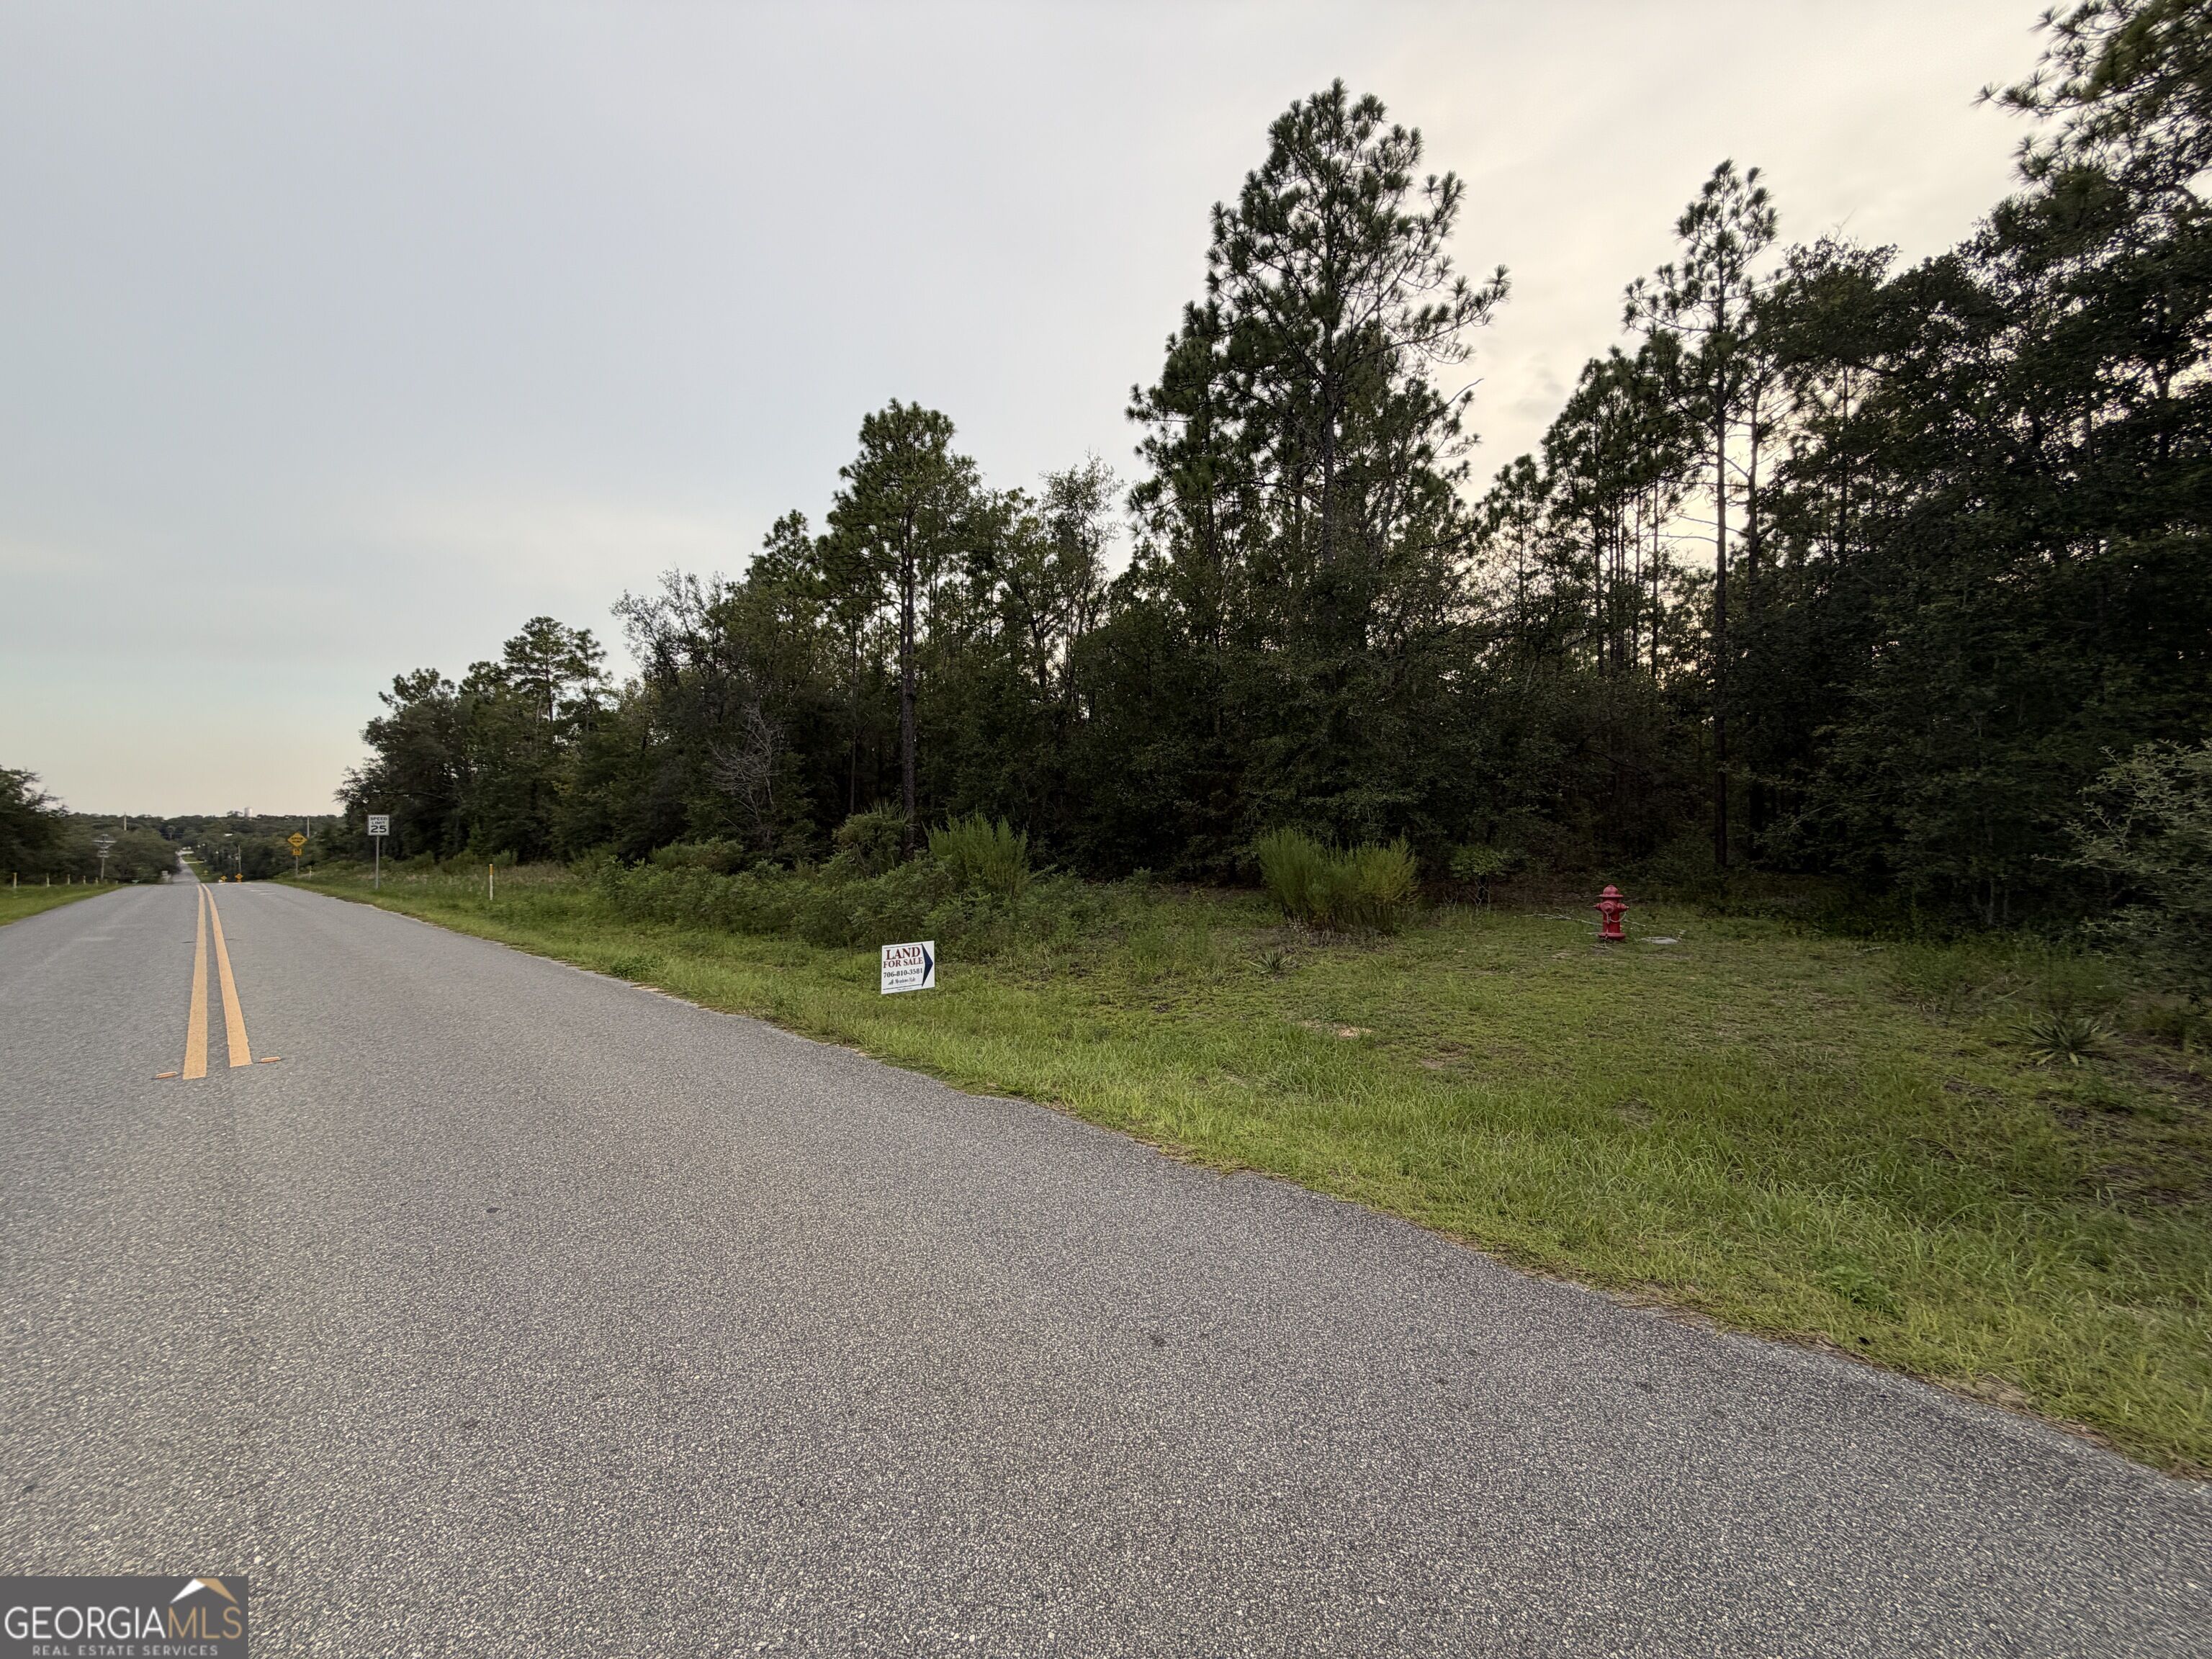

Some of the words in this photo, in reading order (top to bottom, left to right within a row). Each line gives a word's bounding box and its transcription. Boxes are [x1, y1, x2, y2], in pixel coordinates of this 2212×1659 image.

[886, 947, 921, 960] LAND
[883, 960, 902, 968] FOR
[903, 957, 923, 966] SALE
[884, 968, 922, 978] 706-810-3581
